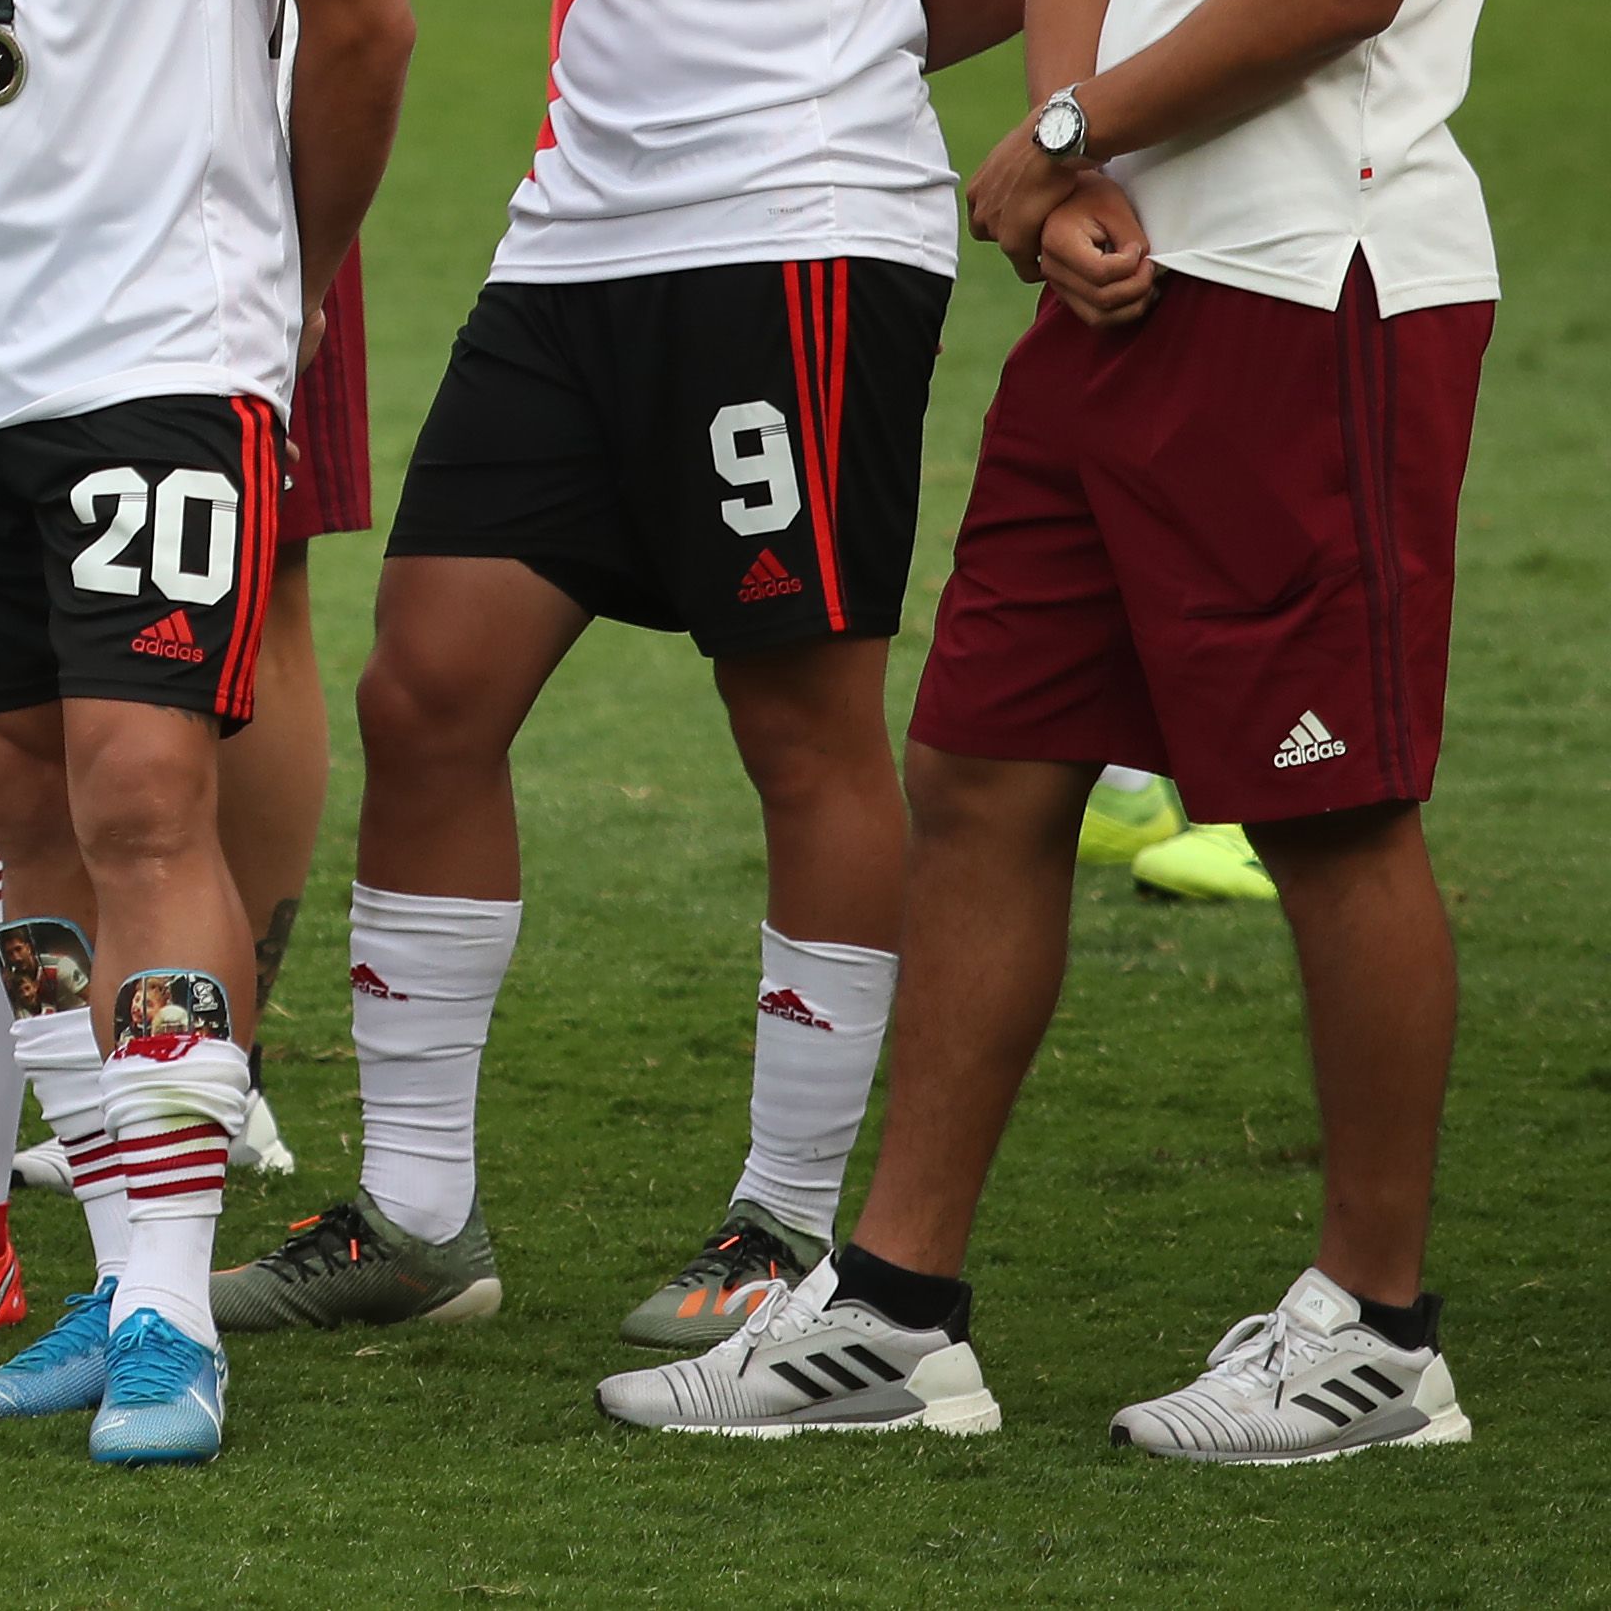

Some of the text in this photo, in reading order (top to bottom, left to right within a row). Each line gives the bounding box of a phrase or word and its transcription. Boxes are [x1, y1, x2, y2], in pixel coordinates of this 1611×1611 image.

[709, 400, 801, 537] 9
[70, 466, 239, 607] 20
[737, 574, 802, 603] adidas
[130, 635, 204, 663] adidas
[1273, 739, 1347, 769] adidas
